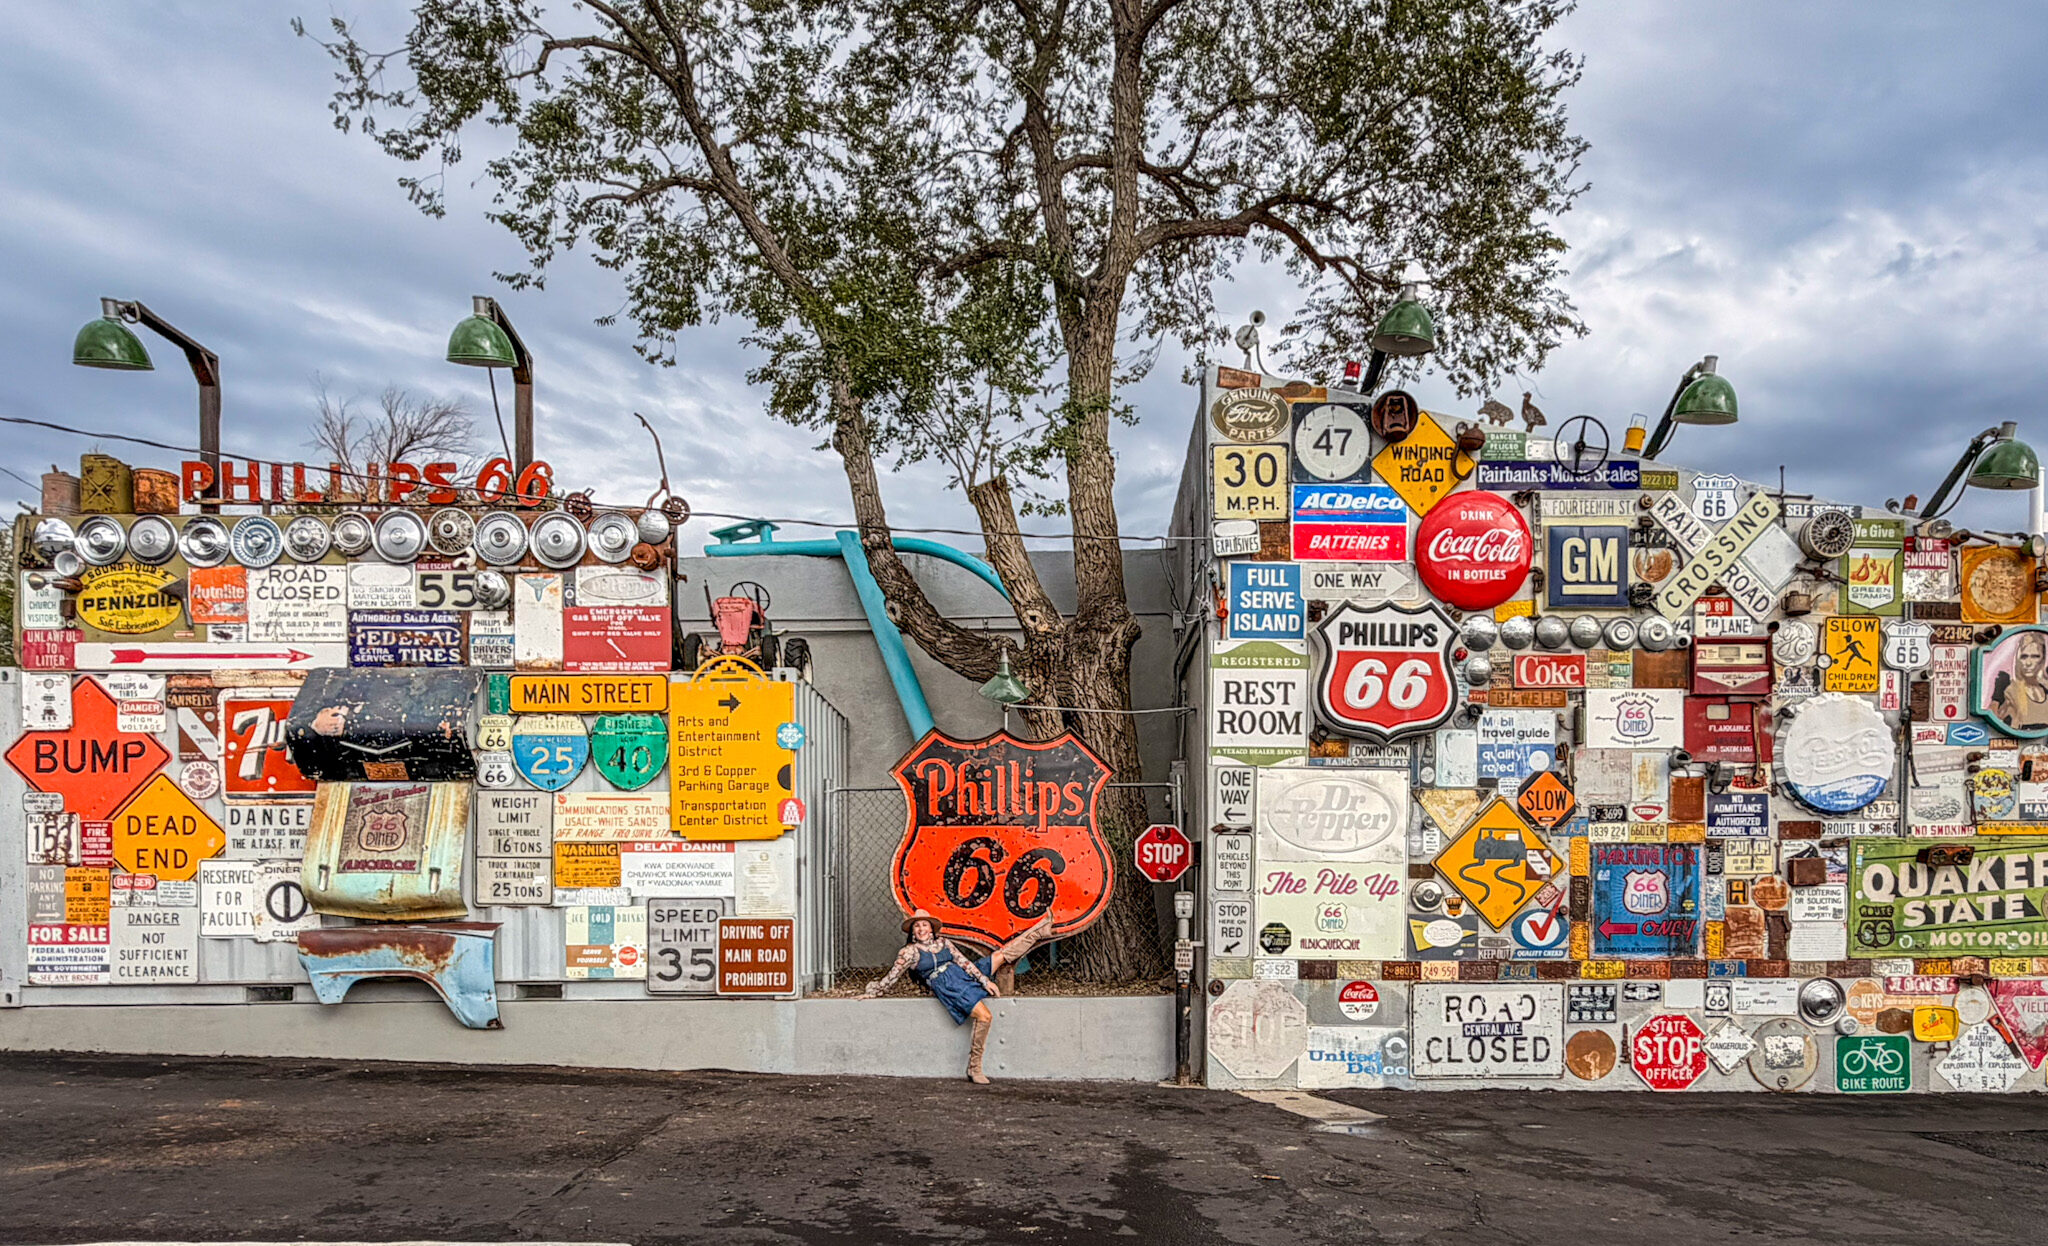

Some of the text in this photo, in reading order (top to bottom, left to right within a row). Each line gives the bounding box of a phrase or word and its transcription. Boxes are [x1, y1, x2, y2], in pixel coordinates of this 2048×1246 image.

[1222, 389, 1279, 408] GENUINE
[1228, 403, 1275, 422] Ford
[1228, 426, 1275, 441] PARTS
[1312, 428, 1353, 457] 47
[1391, 444, 1454, 463] WINDING
[1223, 452, 1278, 488] 30
[1400, 467, 1444, 483] ROAD
[1594, 465, 1639, 483] Scales
[182, 458, 554, 507] PHILLIPS 66
[1226, 496, 1280, 511] M.P.H.
[1300, 492, 1405, 510] ACDelco
[1459, 510, 1494, 521] DRINK
[1552, 501, 1619, 517] FOURTEENTH
[1703, 501, 1727, 517] 66
[1658, 498, 1701, 550] RAIL
[1869, 525, 1896, 539] Give
[1215, 539, 1260, 554] EXPLOSIVES
[1308, 534, 1391, 550] BATTERIES
[1428, 523, 1526, 566] Coca-Cola
[1561, 536, 1619, 583] GM
[1664, 501, 1771, 610] CROSSING
[1903, 552, 1949, 567] SMOKING
[268, 569, 327, 583] ROAD
[1246, 568, 1289, 587] FULL
[1313, 573, 1383, 587] ONE WAY
[1447, 569, 1507, 580] IN BOTTLES
[192, 583, 246, 600] Autolite
[256, 586, 340, 600] CLOSED
[1722, 563, 1771, 614] ROAD
[1239, 590, 1296, 609] SERVE
[351, 613, 402, 623] AUTHORIZED
[1233, 613, 1301, 632] ISLAND
[1829, 619, 1878, 633] SLOW
[27, 630, 78, 643] UNLAWFUL
[355, 626, 463, 646] FEDERAL
[1338, 621, 1440, 648] PHILLIPS
[46, 642, 58, 654] TO
[397, 647, 462, 662] TIRES
[1895, 647, 1919, 664] 66
[35, 655, 66, 667] LITTER
[1220, 657, 1302, 667] REGISTERED
[1934, 660, 1968, 670] PARKING
[1519, 657, 1581, 686] Coke
[1827, 672, 1877, 682] CHILDREN
[1343, 658, 1433, 710] 66
[1847, 682, 1875, 691] PLAY
[523, 683, 653, 704] MAIN STREET
[1222, 680, 1296, 706] REST
[122, 703, 160, 713] DANGER
[677, 715, 729, 727] Arts and
[1217, 710, 1304, 736] ROOM
[485, 735, 506, 747] 66
[677, 731, 761, 742] Entertainment
[1482, 727, 1551, 740] travel guide
[34, 739, 147, 774] BUMP
[677, 746, 723, 757] District
[1354, 744, 1409, 757] DOWNTOWN
[530, 747, 574, 774] 25
[607, 746, 652, 774] 40
[678, 765, 757, 778] 3rd & Copper
[1219, 771, 1251, 787] ONE
[678, 779, 770, 793] Parking Garage
[916, 757, 1088, 832] Phillips
[1219, 789, 1250, 805] WAY
[1315, 783, 1366, 813] Dr
[1526, 790, 1567, 811] SLOW
[491, 797, 540, 808] WEIGHT
[679, 800, 767, 813] Transportation
[1713, 803, 1763, 813] ADMITTANCE
[498, 812, 531, 823] LIMIT
[679, 814, 768, 826] Center District
[1290, 798, 1390, 842] Pepper
[1715, 816, 1762, 827] AUTHORIZED
[126, 815, 198, 837] DEAD
[1630, 826, 1666, 836] 66DINER
[1707, 826, 1749, 836] PERSONNEL
[1826, 822, 1858, 835] ROUTE
[1913, 824, 1928, 836] NO
[231, 839, 246, 850] THE
[290, 839, 304, 850] RY.
[498, 838, 542, 853] 16 TONS
[558, 844, 618, 856] WARNING
[634, 842, 727, 852] DELAT' DANNI
[135, 849, 189, 870] END
[1141, 843, 1184, 864] STOP
[1217, 852, 1250, 861] VEHICLES
[943, 836, 1066, 920] 66
[1262, 868, 1400, 901] The Pile Up
[1633, 877, 1660, 893] 66
[492, 883, 543, 897] 25 TONS
[1807, 888, 1842, 896] LOITERING
[216, 891, 242, 906] FOR
[1630, 893, 1663, 909] DINER
[654, 909, 718, 923] SPEED
[1217, 904, 1247, 917] STOP
[1323, 907, 1342, 917] 66
[1902, 893, 2026, 927] STATE
[127, 912, 180, 925] DANGER
[1320, 918, 1344, 930] DINER
[30, 927, 108, 942] FOR SALE
[142, 933, 166, 944] NOT
[661, 928, 711, 943] LIMIT
[722, 925, 790, 940] DRIVING OFF
[1220, 926, 1243, 938] RED
[1930, 931, 2008, 946] MOTOR
[1299, 938, 1361, 950] ALBUQUERQUE
[119, 949, 189, 961] SUFFICIENT
[724, 949, 787, 963] MAIN ROAD
[118, 966, 189, 977] CLEARANCE
[655, 948, 716, 982] 35
[725, 971, 787, 986] PROHIBITED
[1860, 993, 1885, 1009] KEYS
[1464, 1023, 1501, 1037] CENTRAL
[1649, 1020, 1688, 1034] STATE
[1425, 1036, 1551, 1064] CLOSED
[1635, 1038, 1702, 1068] STOP
[1710, 1041, 1749, 1050] DANGEROUS
[1307, 1049, 1382, 1062] United
[1344, 1061, 1408, 1075] Delco
[1645, 1067, 1695, 1081] OFFICER
[1842, 1077, 1907, 1090] BIKE ROUTE
